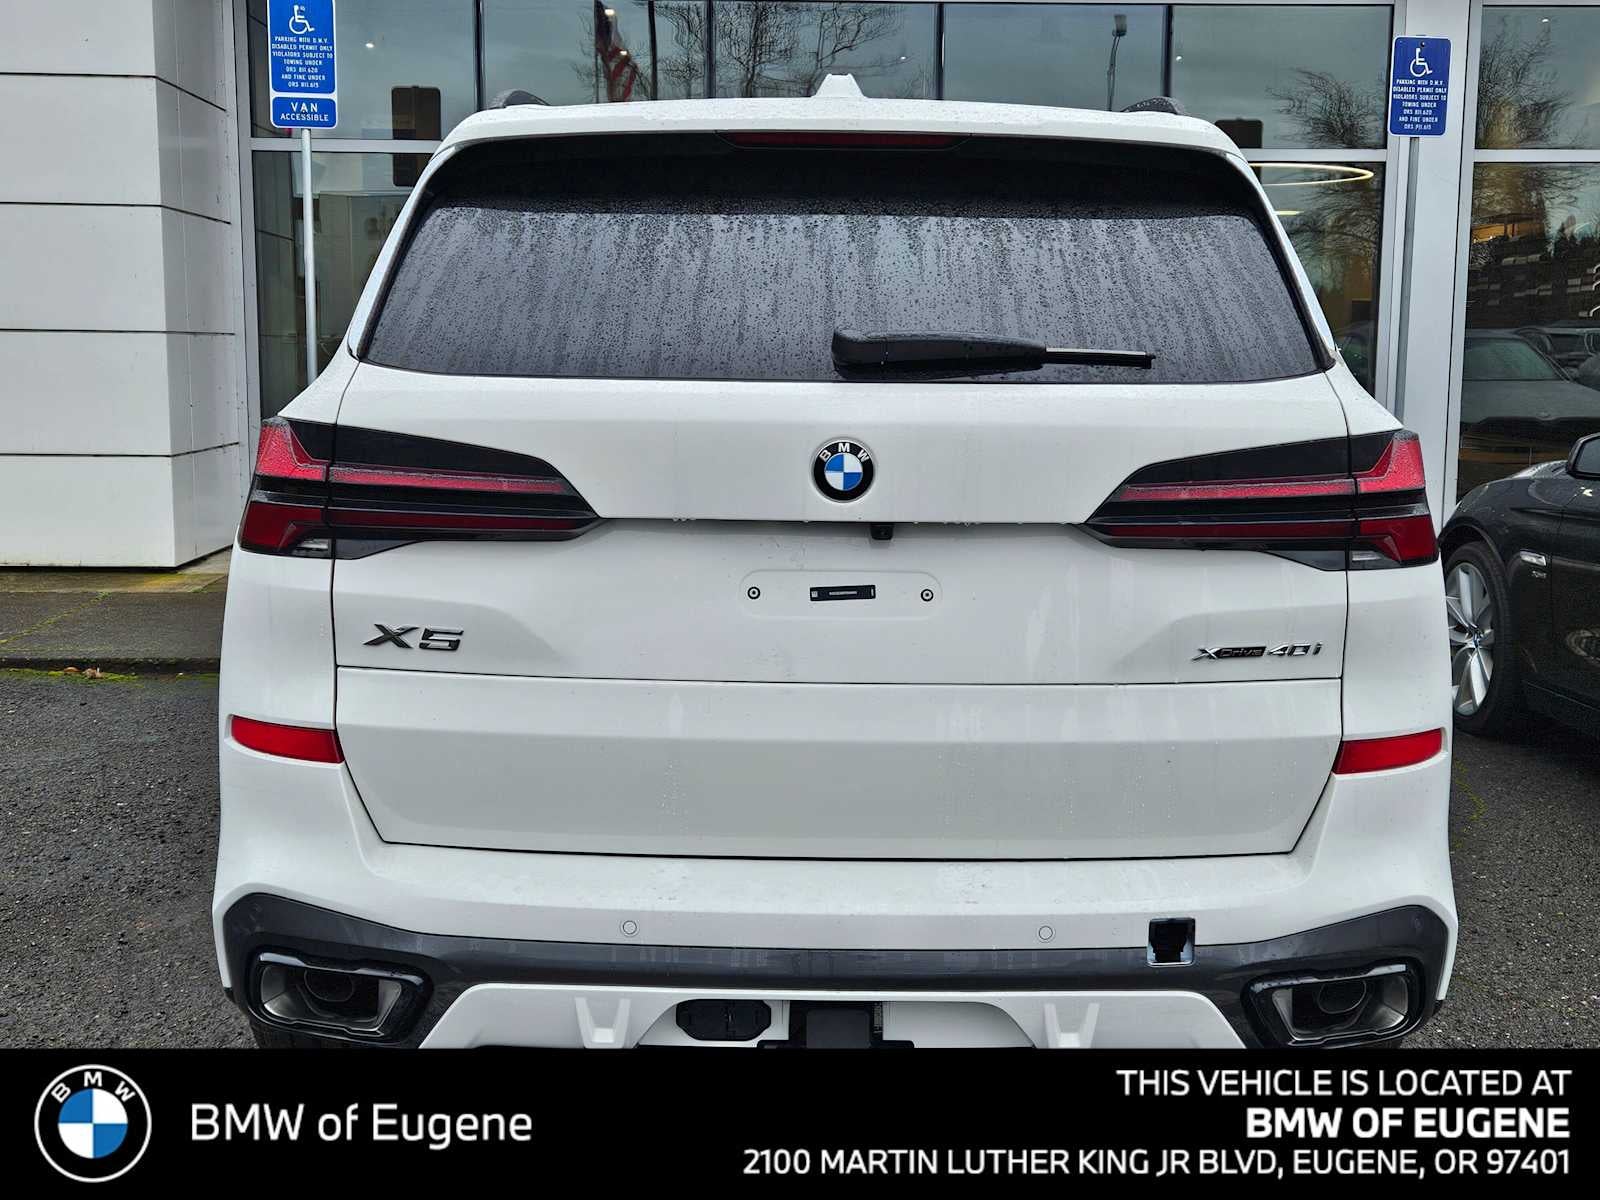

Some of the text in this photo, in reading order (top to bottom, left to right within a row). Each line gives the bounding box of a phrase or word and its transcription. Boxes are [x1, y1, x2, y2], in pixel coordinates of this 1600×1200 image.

[291, 102, 318, 112] VAN
[280, 113, 328, 121] ACCESSIBLE
[819, 443, 869, 462] BMW
[363, 624, 464, 651] X5
